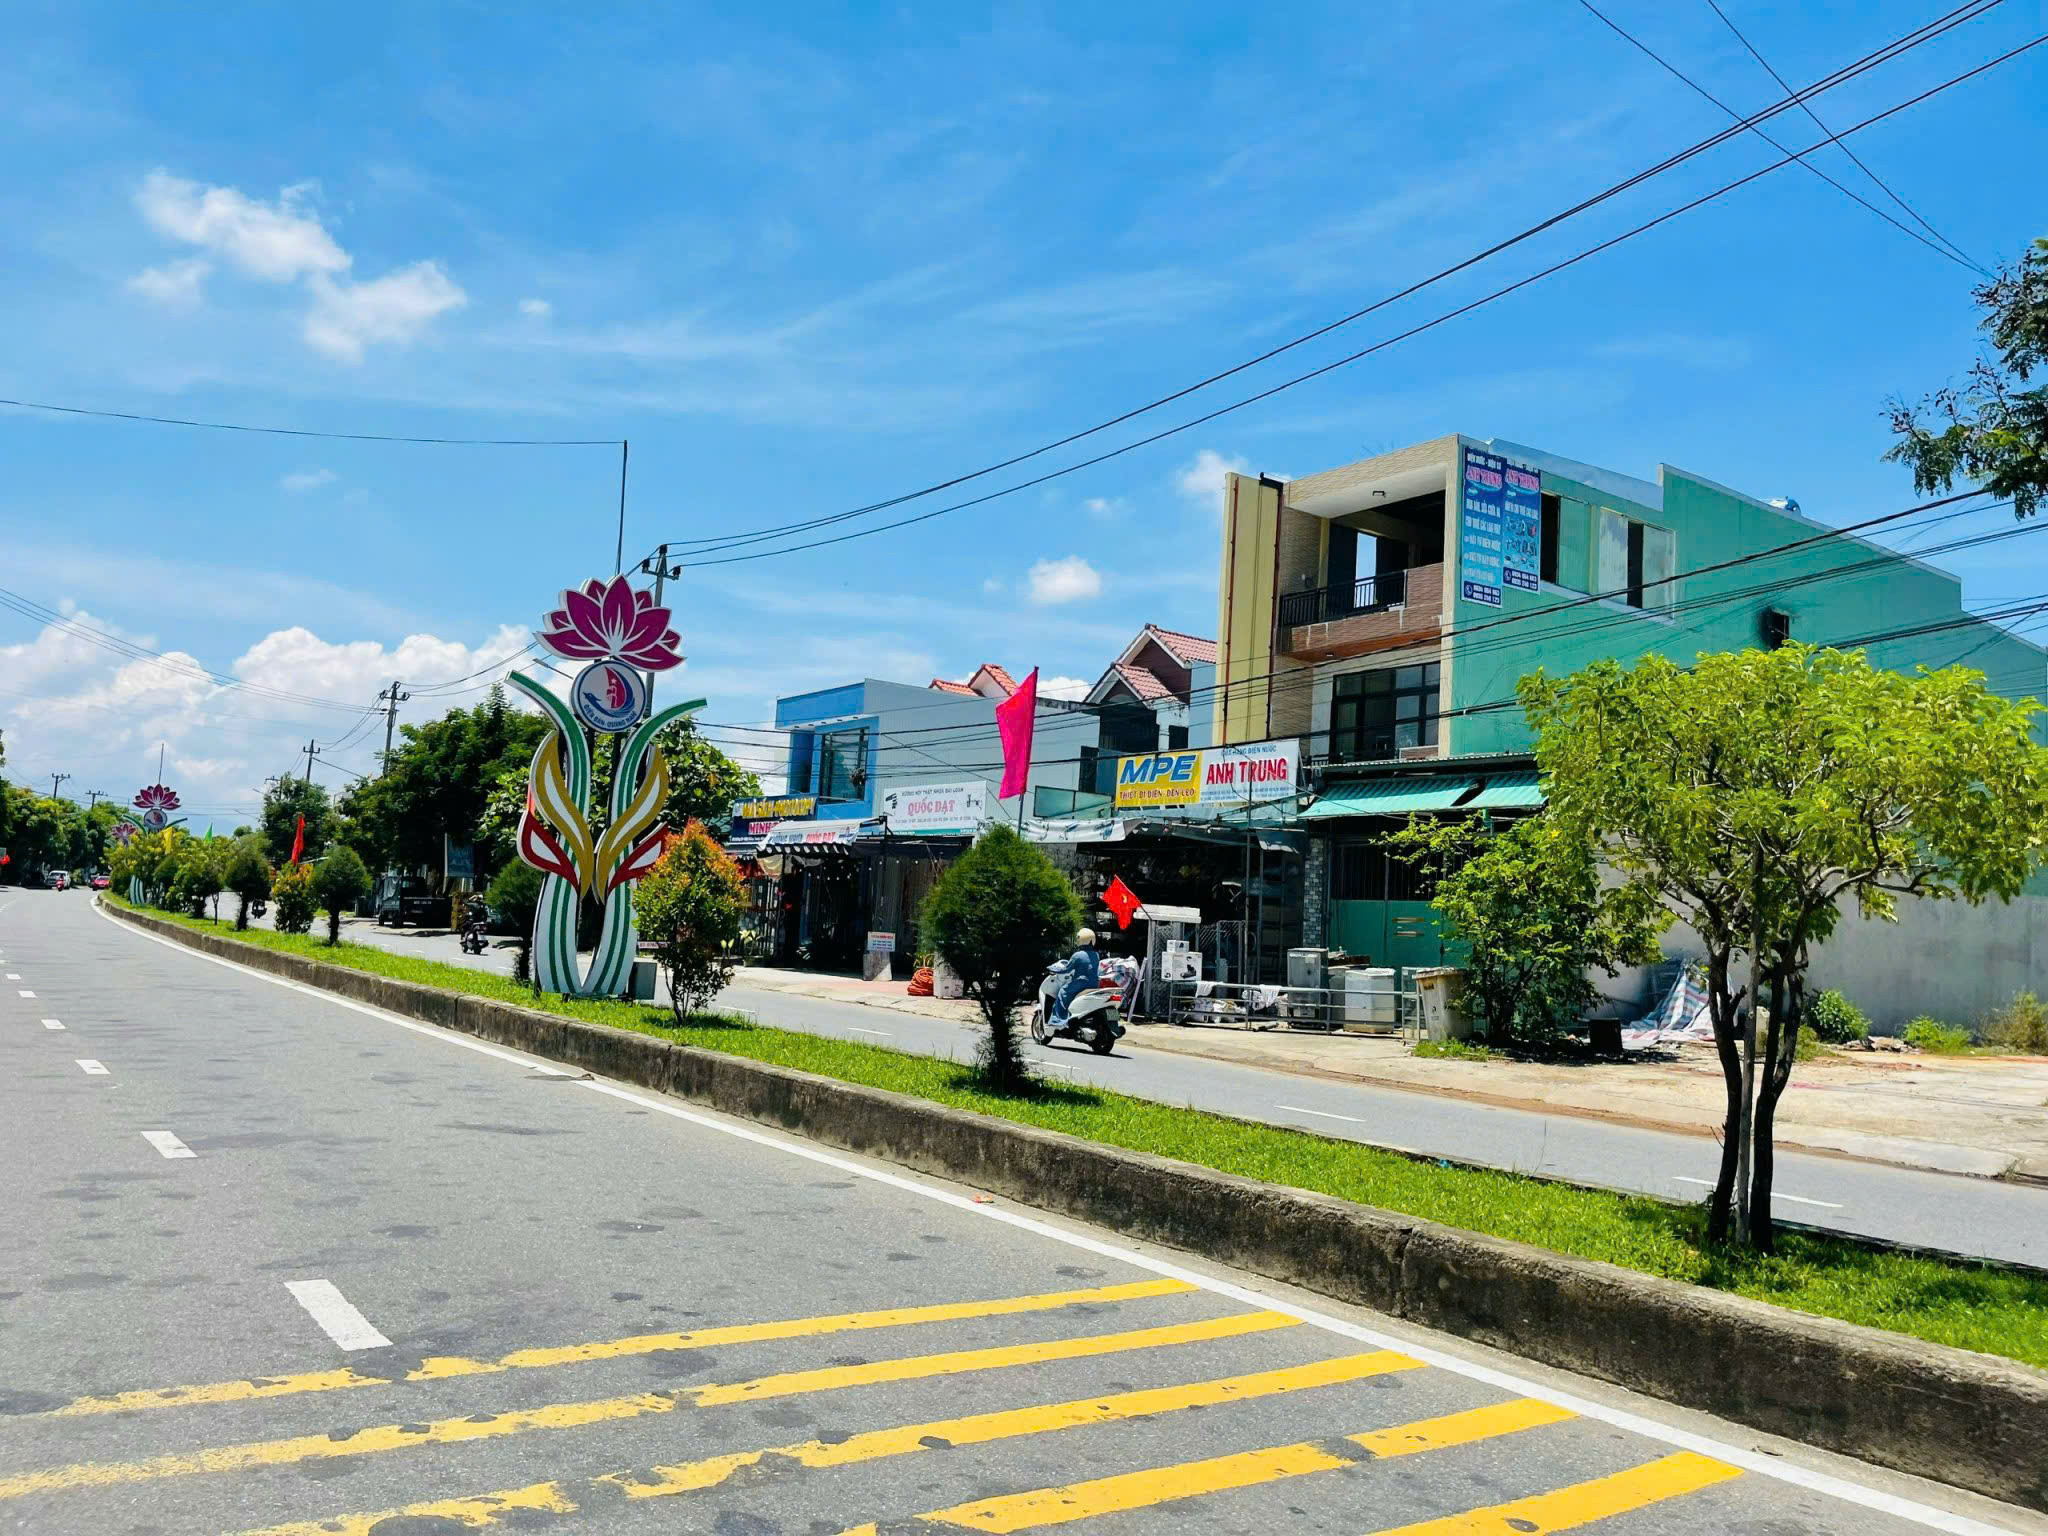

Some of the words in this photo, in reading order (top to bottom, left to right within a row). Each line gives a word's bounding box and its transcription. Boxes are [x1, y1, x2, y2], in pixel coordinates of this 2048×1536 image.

[1119, 754, 1197, 784] MPE
[1206, 762, 1235, 785] ANH
[1238, 757, 1287, 783] TRUNG
[908, 797, 933, 816] QUỐC
[935, 799, 956, 815] ĐẠT
